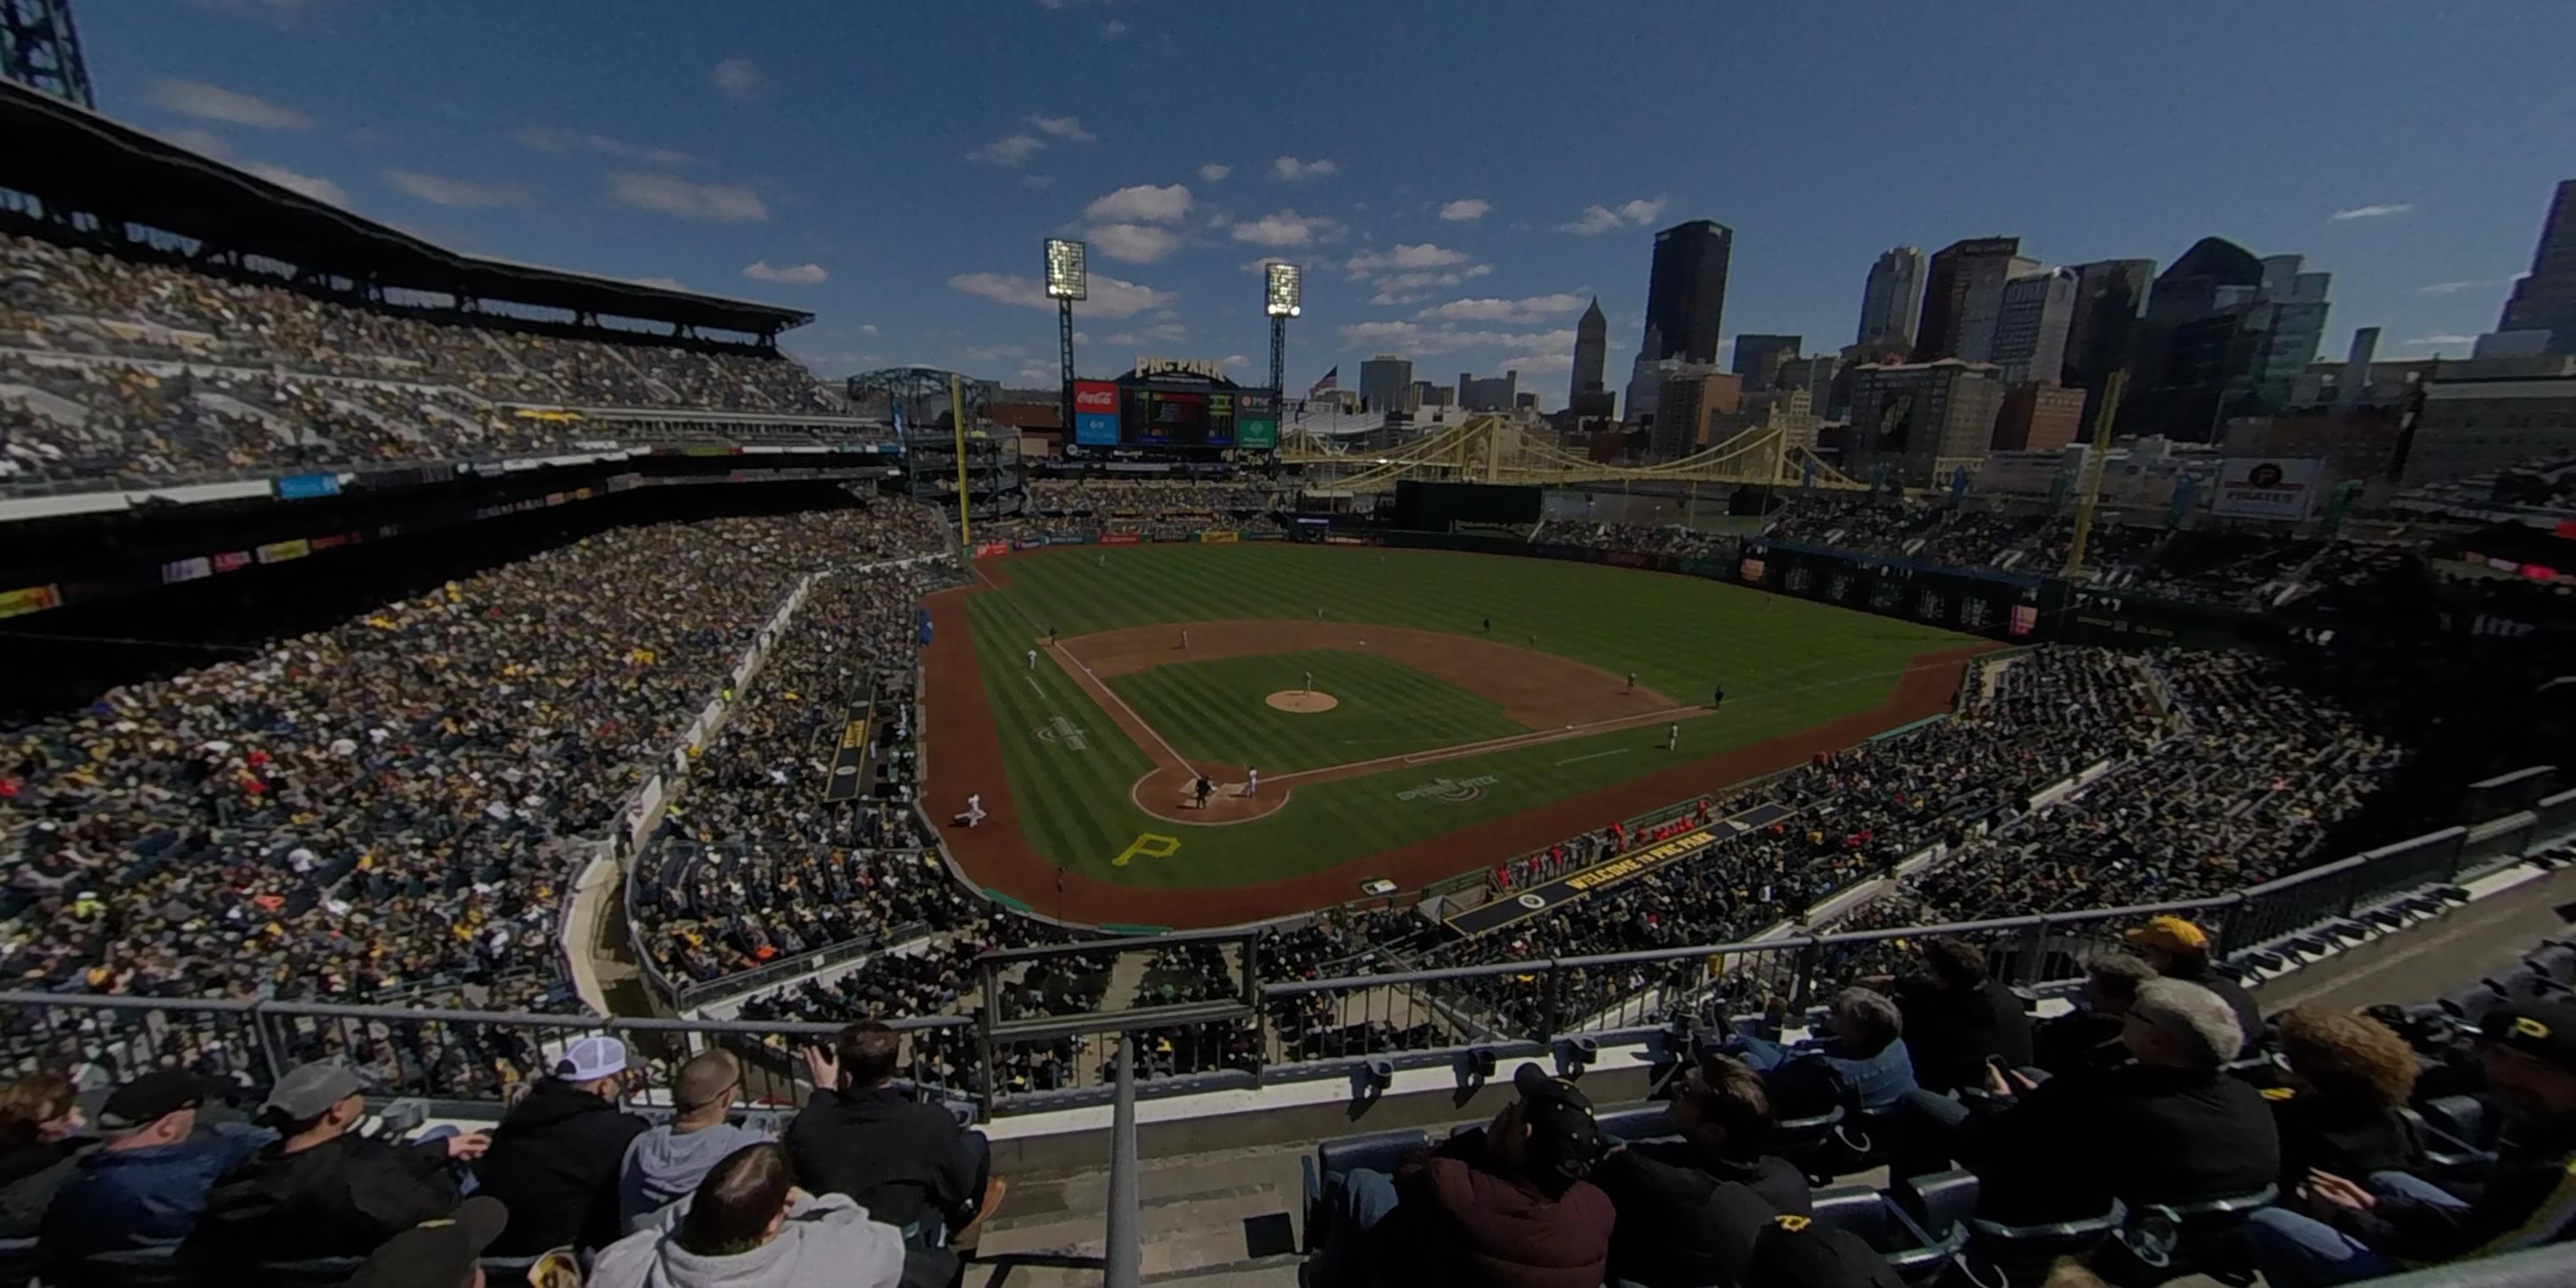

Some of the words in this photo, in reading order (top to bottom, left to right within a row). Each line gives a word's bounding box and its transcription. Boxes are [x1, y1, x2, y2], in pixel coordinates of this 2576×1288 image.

[1135, 356, 1175, 379] PNC
[1176, 358, 1226, 383] PARK
[1111, 832, 1181, 866] P
[1564, 859, 1642, 890] WELCOME
[1635, 852, 1657, 865] TO
[1648, 842, 1685, 860] PNC
[1674, 830, 1718, 850] PARK
